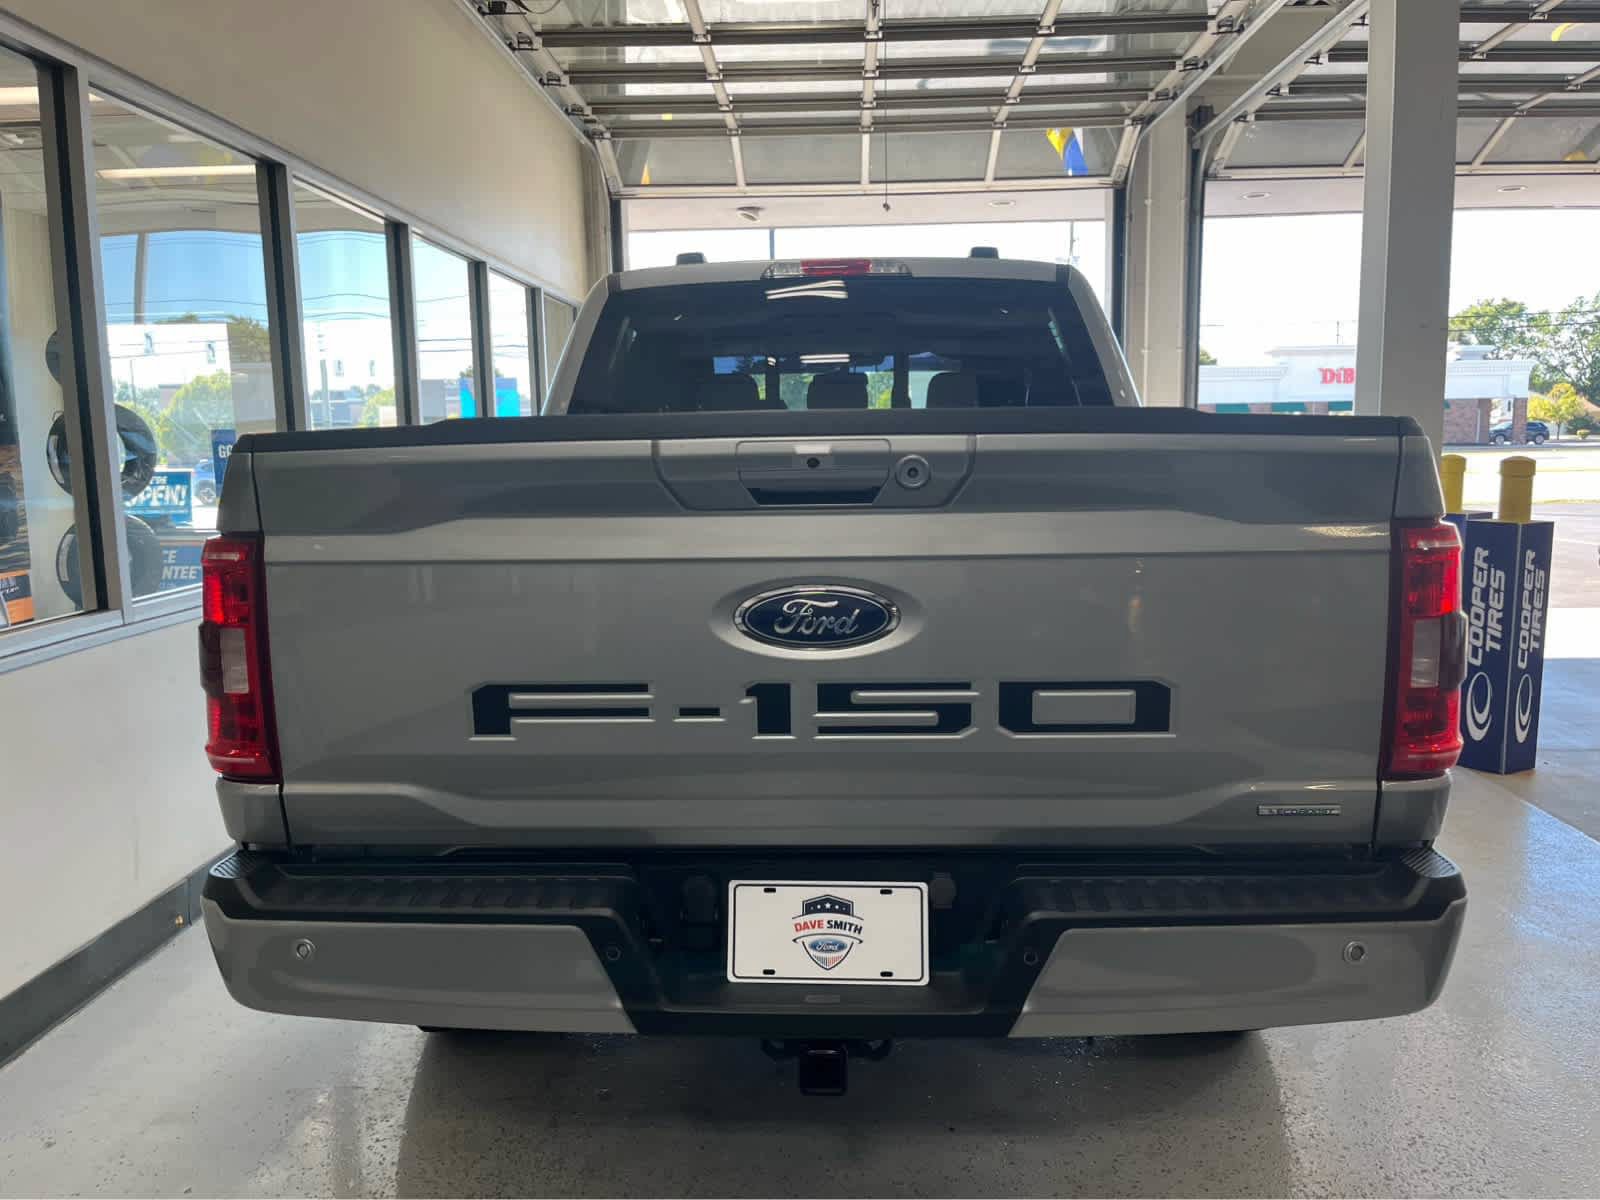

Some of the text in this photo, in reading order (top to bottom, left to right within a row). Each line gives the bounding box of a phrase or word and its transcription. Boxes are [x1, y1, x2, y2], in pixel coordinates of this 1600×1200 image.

[774, 599, 861, 635] Ford
[1468, 546, 1489, 666] COOPER
[1486, 567, 1506, 653] TIRES
[1517, 549, 1536, 670] COOPER
[1530, 568, 1545, 653] TIRES
[470, 681, 1176, 739] F-150
[794, 919, 863, 935] DAVE SMITH
[815, 940, 840, 951] Ford
